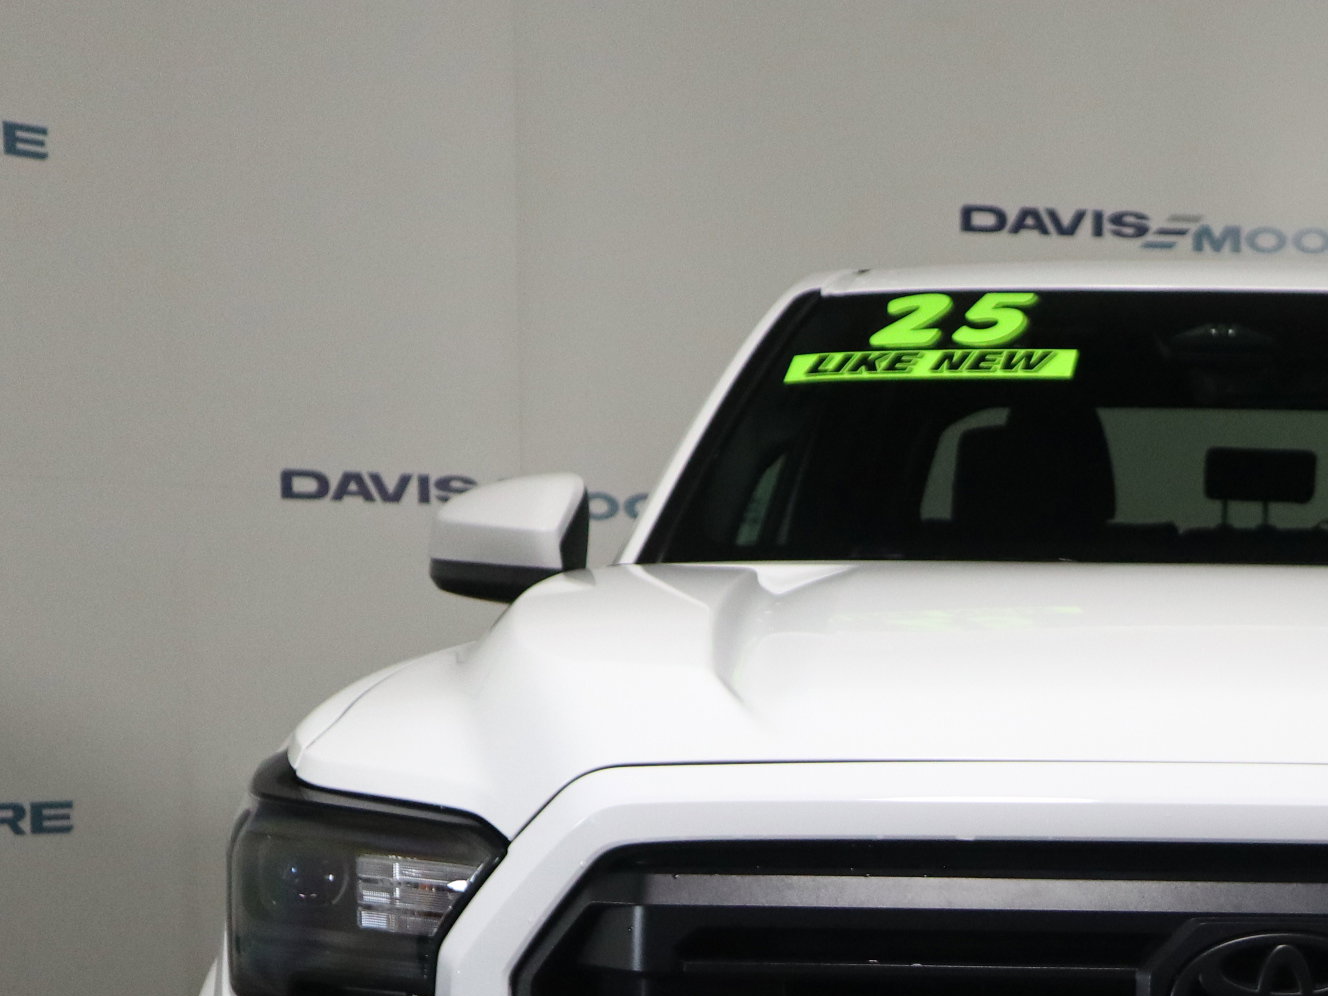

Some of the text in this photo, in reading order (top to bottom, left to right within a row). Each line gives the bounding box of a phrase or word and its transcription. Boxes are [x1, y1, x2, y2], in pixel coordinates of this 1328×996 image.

[960, 204, 1150, 239] DAVIS
[869, 292, 1039, 349] 25
[803, 350, 1057, 376] LIKE NEW
